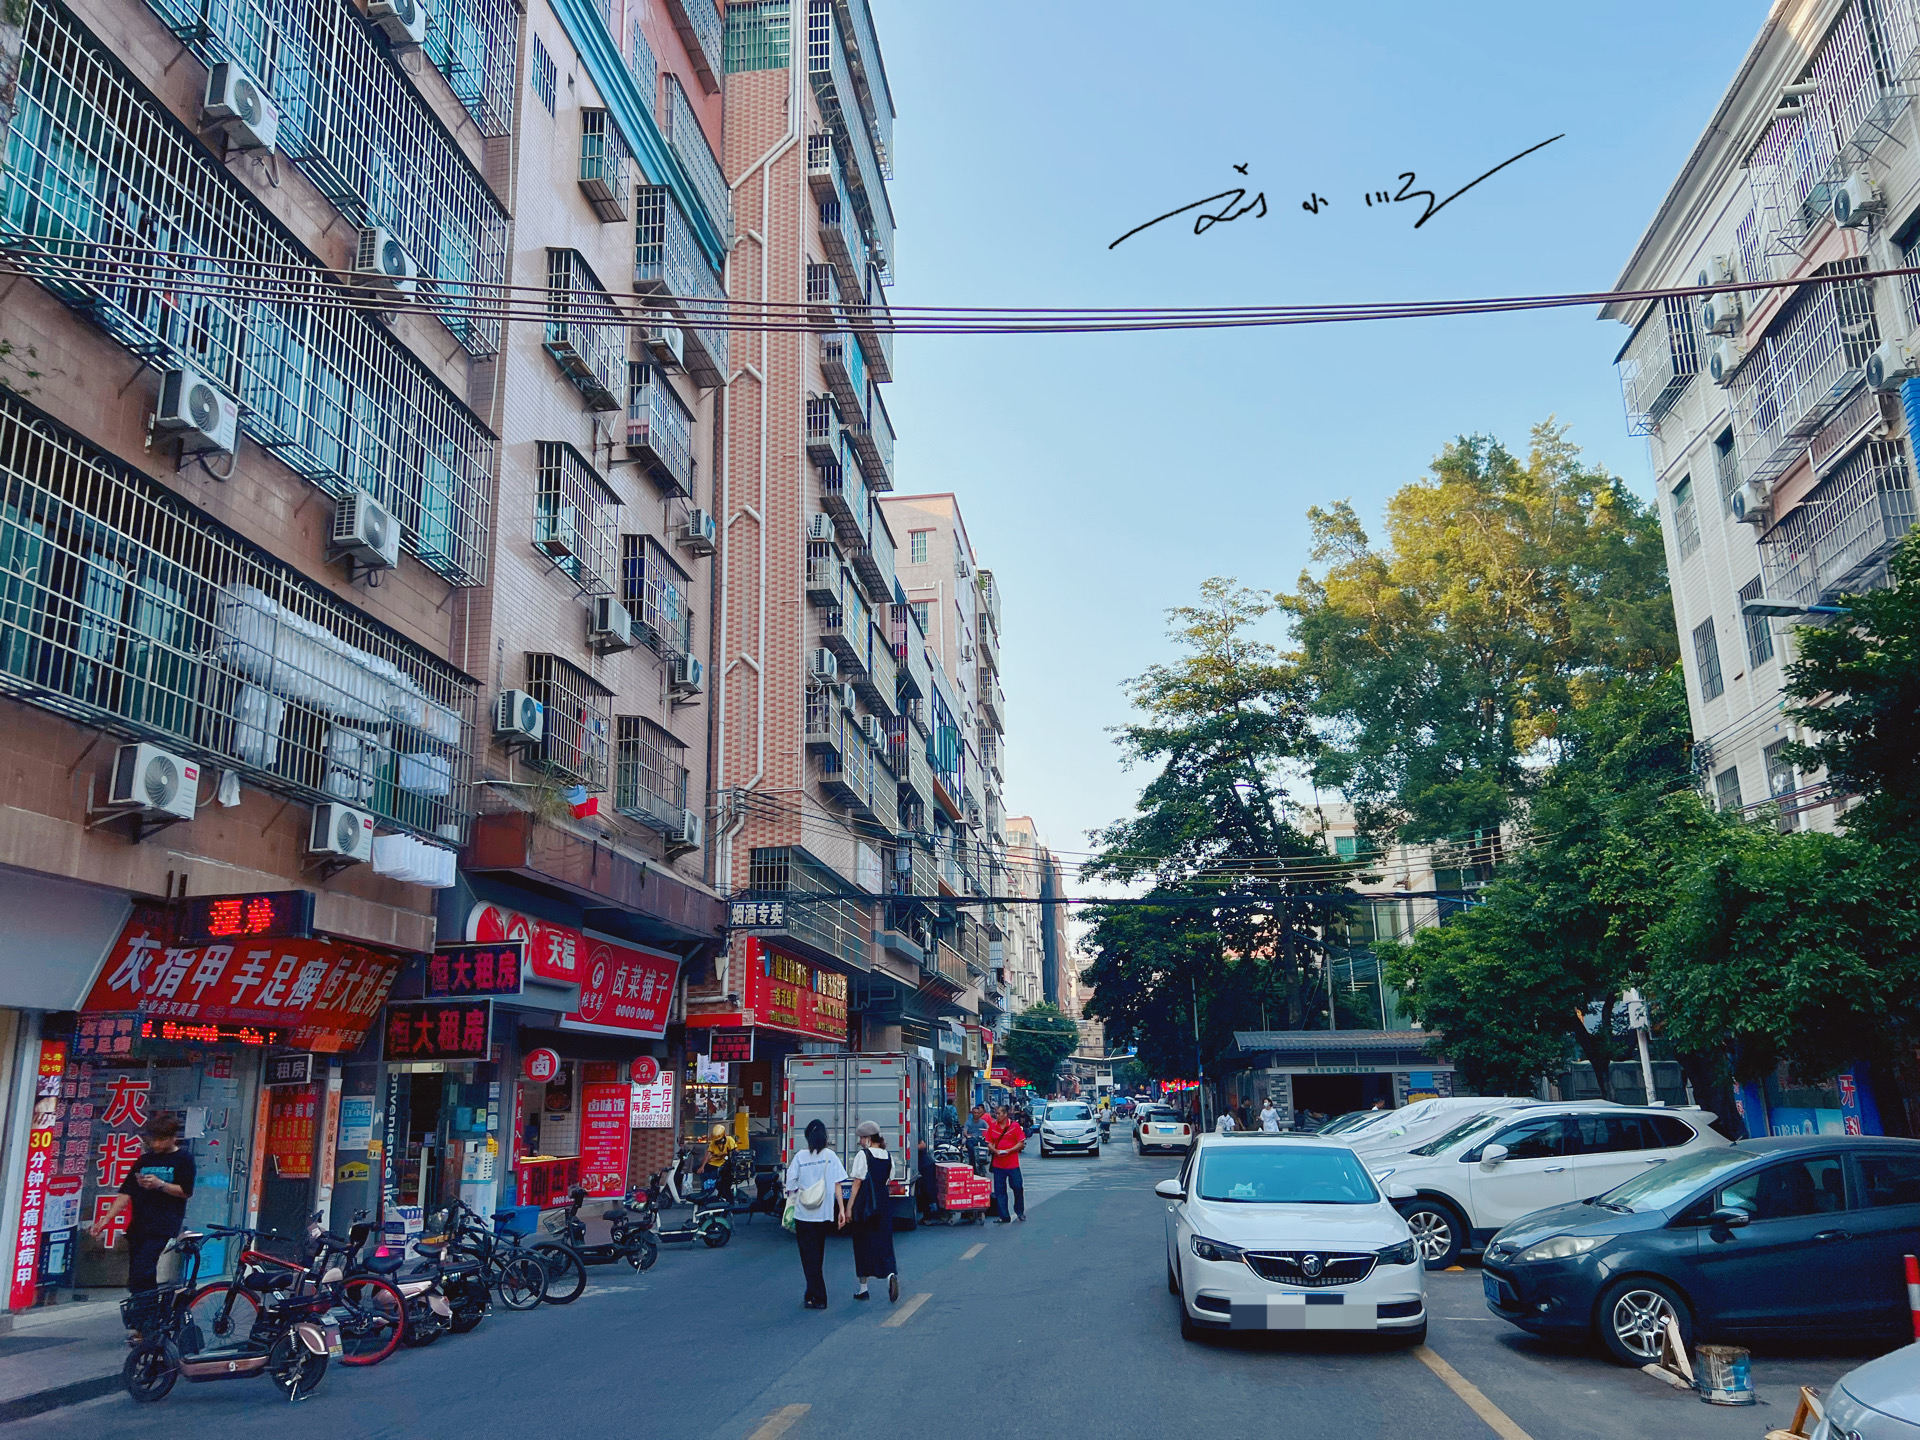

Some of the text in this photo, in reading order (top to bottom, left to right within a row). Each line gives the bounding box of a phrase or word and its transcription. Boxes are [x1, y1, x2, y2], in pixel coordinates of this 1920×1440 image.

[731, 902, 783, 925] 烟酒专卖
[547, 933, 576, 971] 天福
[107, 931, 330, 1011] 灰指甲 手足癣
[428, 950, 518, 990] 恒大租房
[313, 955, 398, 1018] 恒大租房
[612, 961, 669, 1005] 卤菜铺子
[80, 1019, 133, 1036] 灰指甲
[389, 1009, 485, 1055] 恒大租房
[40, 1064, 62, 1074] 咨询
[276, 1060, 305, 1080] 租房
[531, 1054, 550, 1077] 卤
[588, 1098, 625, 1112] 卤味饭
[632, 1089, 672, 1101] 一房一厅
[632, 1102, 672, 1114] 两房一厅
